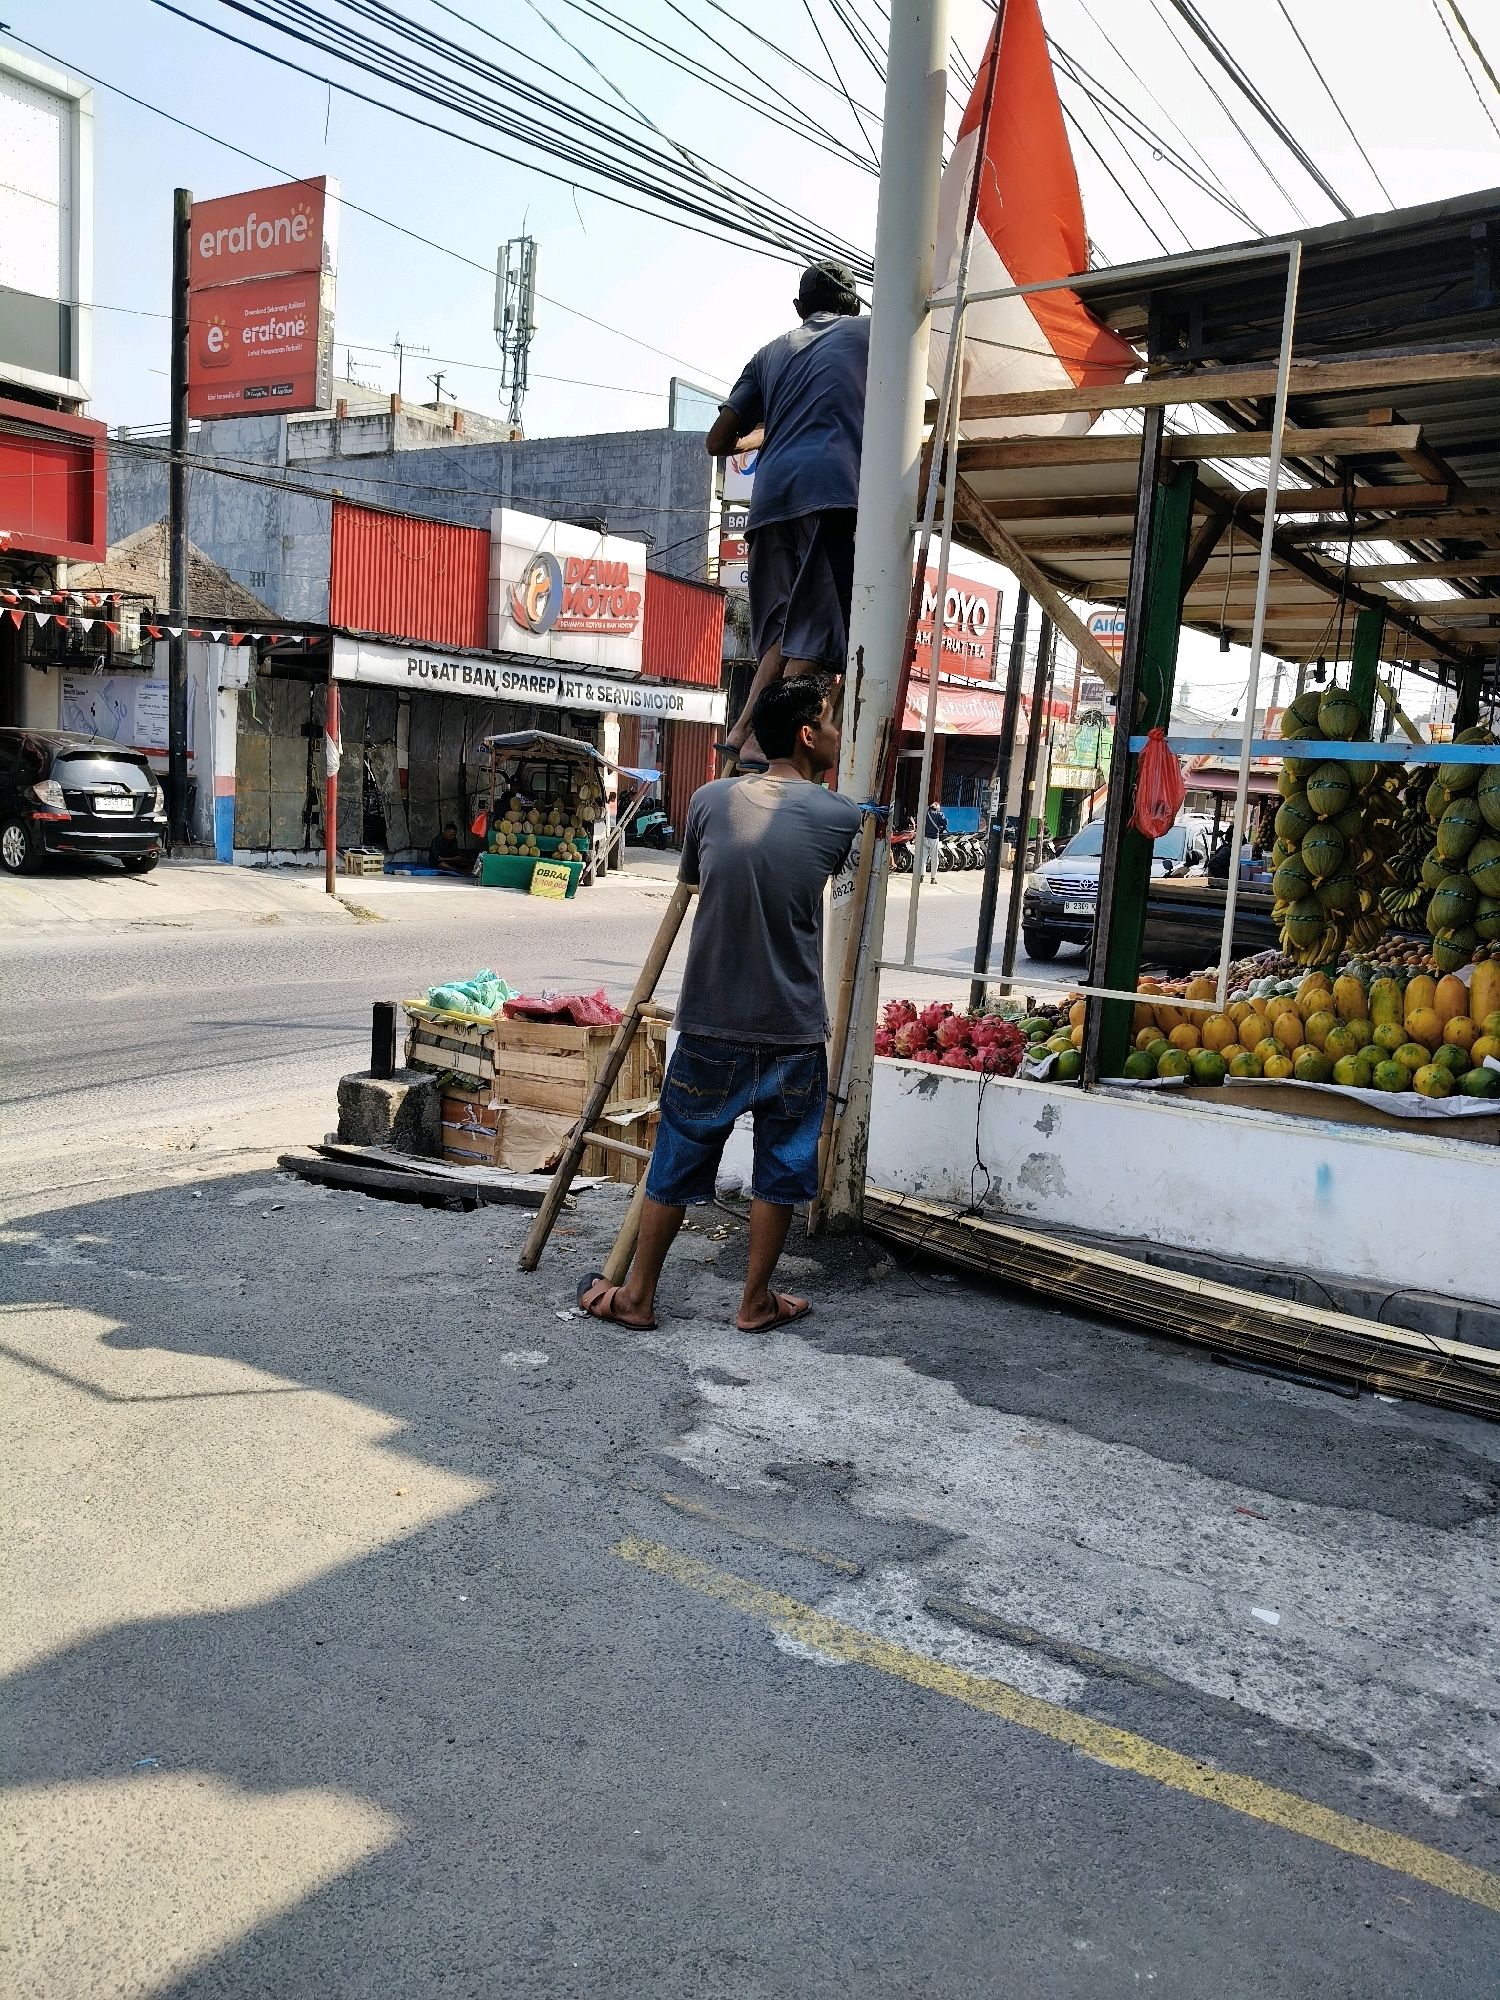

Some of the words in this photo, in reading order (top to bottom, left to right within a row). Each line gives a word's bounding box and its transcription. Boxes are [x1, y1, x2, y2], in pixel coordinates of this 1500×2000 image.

[200, 212, 308, 259] erafone
[242, 317, 306, 344] erafone
[563, 557, 629, 588] DEWA
[561, 587, 642, 618] MOTOR
[560, 621, 585, 629] DEWANYA
[585, 621, 602, 629] SERVIS
[1093, 618, 1126, 632] Alfa
[941, 635, 966, 655] FRUIT
[964, 642, 986, 658] TEA
[407, 657, 460, 682] PUSAT
[585, 683, 595, 701] &
[597, 685, 642, 707] SERVIS
[643, 692, 684, 711] MOTOR
[537, 868, 568, 881] OBRAL
